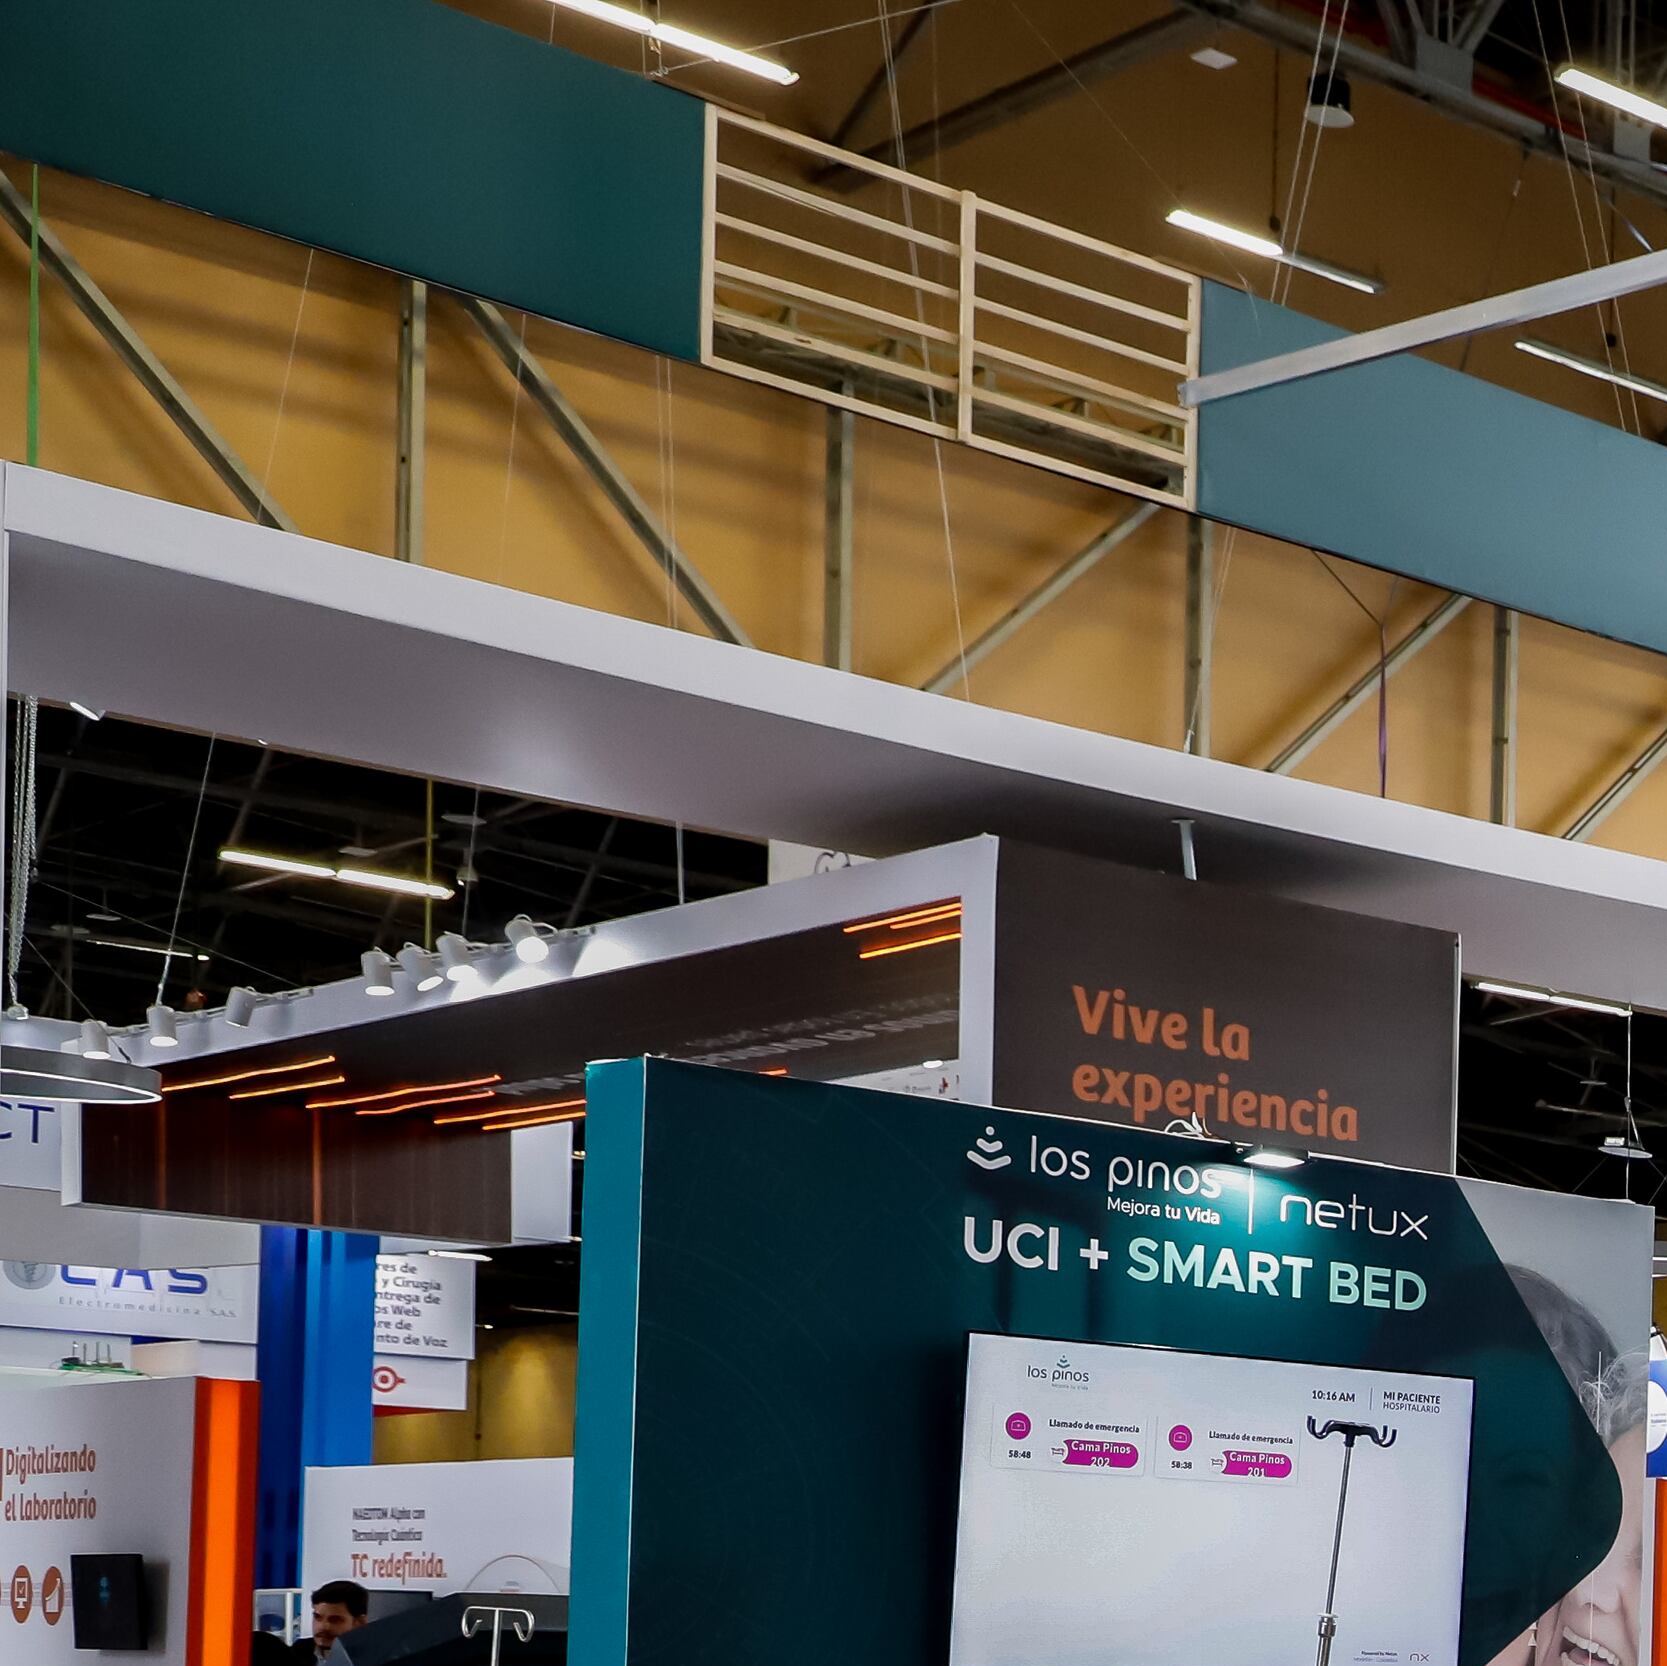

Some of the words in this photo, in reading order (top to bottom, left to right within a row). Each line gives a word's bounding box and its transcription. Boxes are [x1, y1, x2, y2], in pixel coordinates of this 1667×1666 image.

[1072, 983, 1189, 1051] Vive
[1203, 1006, 1251, 1062] la
[1072, 1062, 1359, 1142] experiencia
[1030, 1134, 1092, 1182] los
[1107, 1156, 1222, 1201] pinos
[1280, 1193, 1429, 1241] netux
[1107, 1196, 1160, 1218] Mejora
[1165, 1203, 1182, 1220] tu
[1184, 1207, 1221, 1226] Vida
[963, 1215, 1060, 1272] UCI
[1126, 1237, 1314, 1299] SMART
[1329, 1261, 1428, 1312] BED
[1027, 1365, 1048, 1379] los
[1051, 1368, 1090, 1383] pinos
[1311, 1389, 1338, 1402] 10:16
[1338, 1391, 1356, 1403] AM
[1383, 1390, 1397, 1402] MI
[1397, 1392, 1441, 1405] PACIENTE
[1382, 1401, 1441, 1414] HOSPITALARIO
[1049, 1419, 1083, 1430] Llamado
[1084, 1421, 1095, 1431] de
[1095, 1424, 1140, 1434] emergencia
[1208, 1430, 1241, 1441] Llamado
[1241, 1433, 1251, 1443] de
[1251, 1435, 1294, 1446] emergencia
[1008, 1449, 1032, 1459] 58:48
[1071, 1440, 1101, 1453] Cama
[1102, 1442, 1132, 1455] Pinos
[5, 1443, 97, 1485] Digitalizando
[1090, 1456, 1111, 1468] 202
[1229, 1451, 1258, 1463] Cama
[1258, 1453, 1286, 1466] Pinos
[1247, 1467, 1266, 1478] 201
[4, 1492, 17, 1522] el
[19, 1488, 97, 1521] laboratorio
[351, 1552, 369, 1579] TC
[372, 1551, 448, 1586] redefinida.
